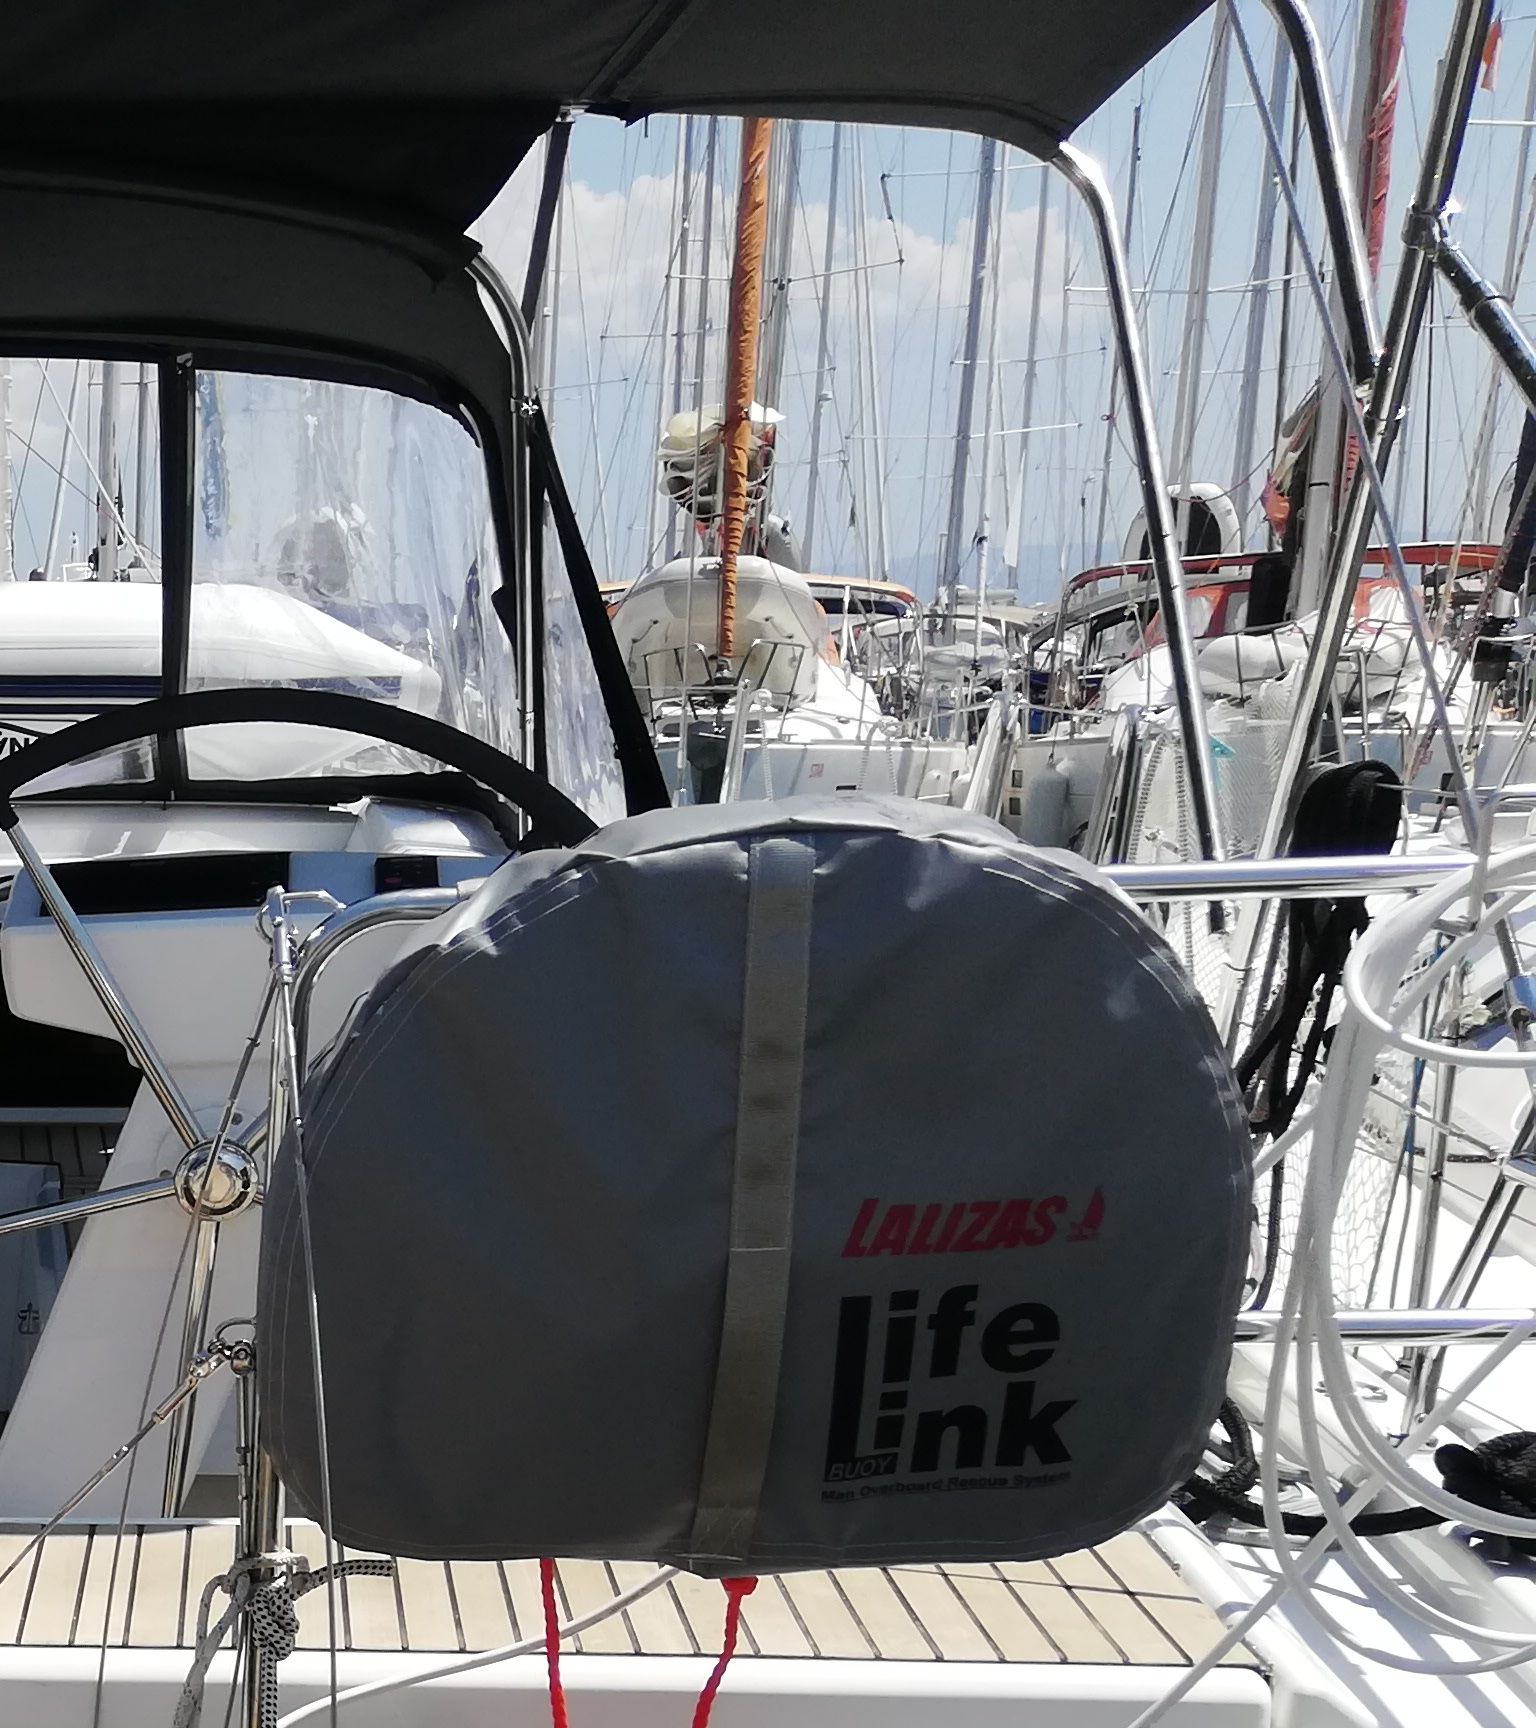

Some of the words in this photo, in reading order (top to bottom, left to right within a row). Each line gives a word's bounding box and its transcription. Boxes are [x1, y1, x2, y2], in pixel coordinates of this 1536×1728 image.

[840, 1194, 1068, 1259] LALIZAS
[827, 1456, 894, 1482] BUOY
[821, 1489, 855, 1501] Man
[859, 1478, 943, 1497] Overboard
[947, 1476, 1009, 1490] Rescue
[1013, 1471, 1071, 1488] System
